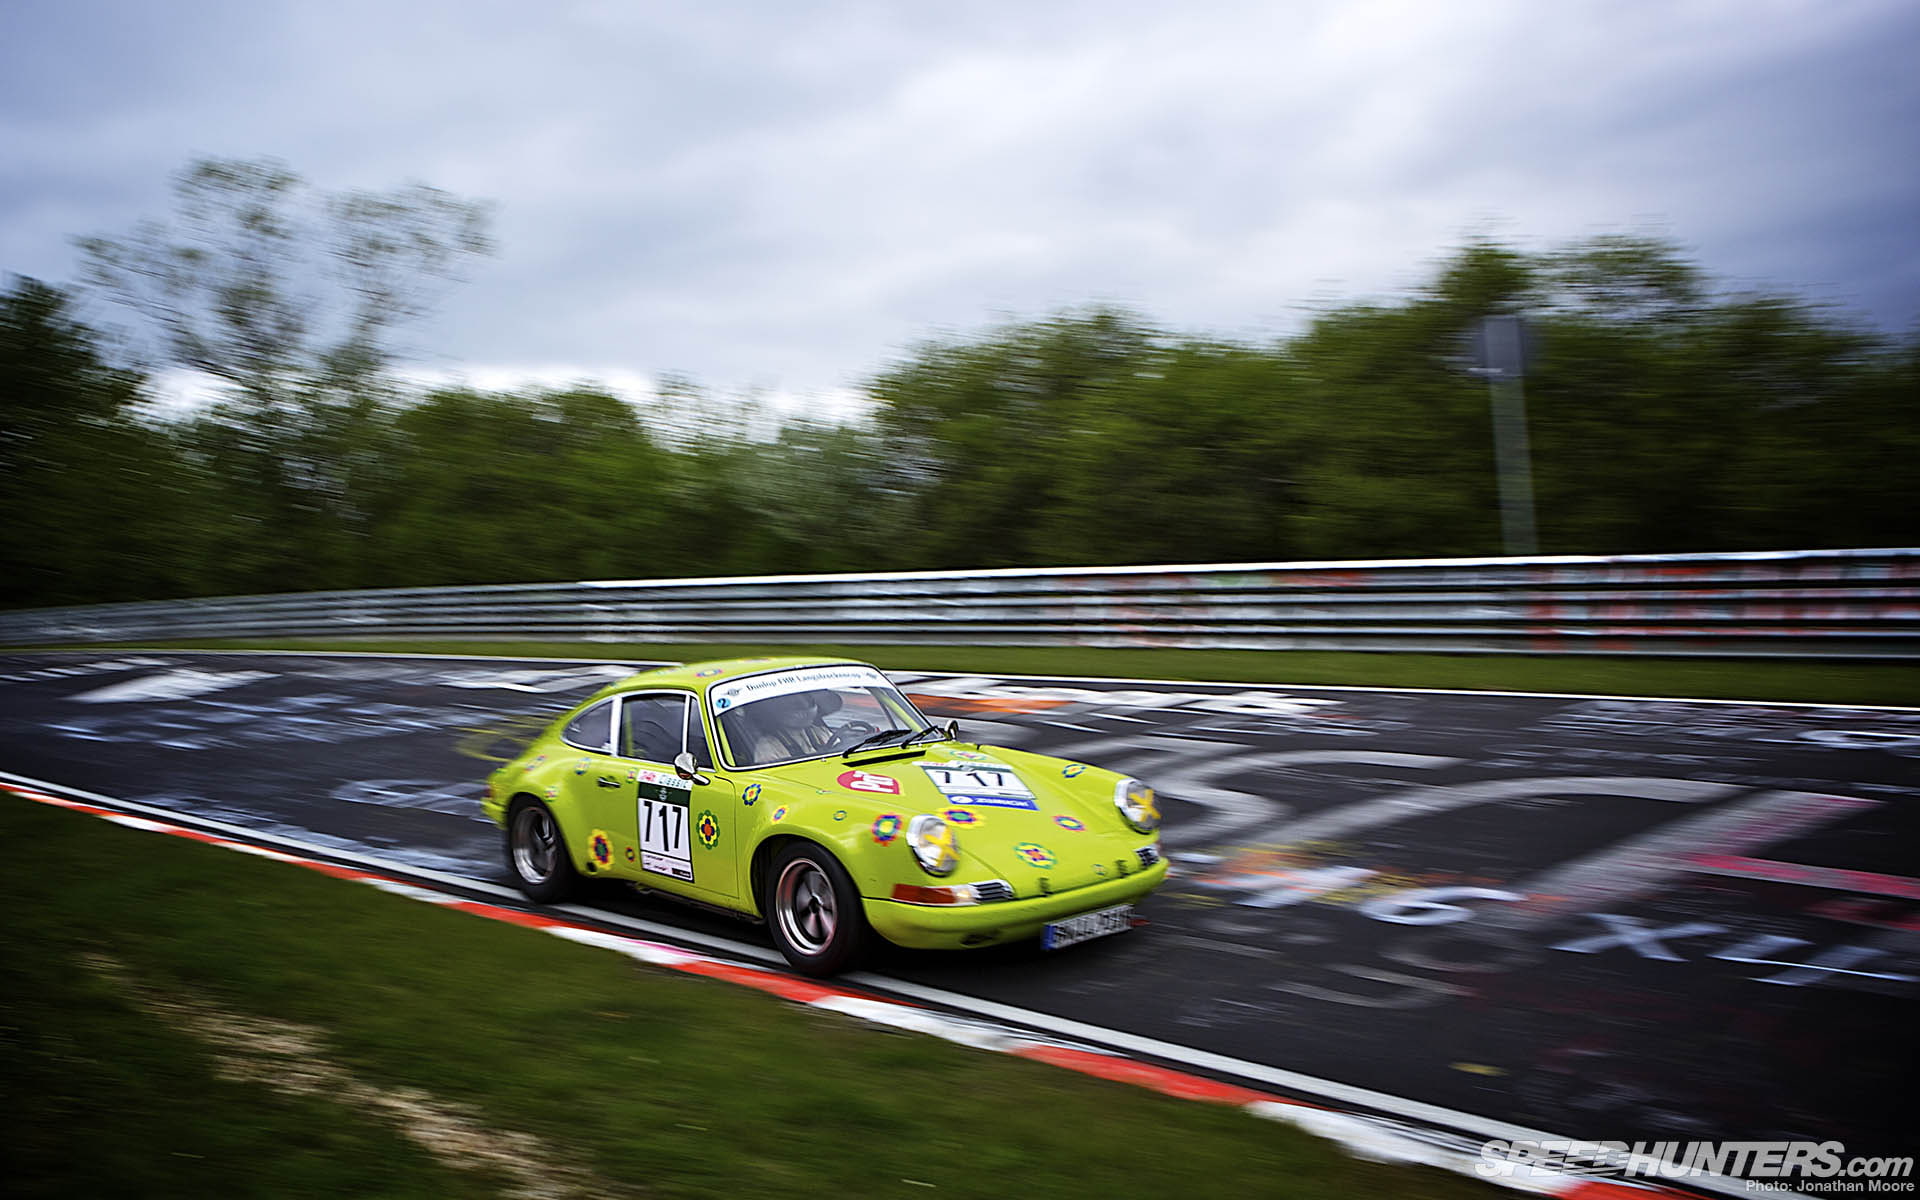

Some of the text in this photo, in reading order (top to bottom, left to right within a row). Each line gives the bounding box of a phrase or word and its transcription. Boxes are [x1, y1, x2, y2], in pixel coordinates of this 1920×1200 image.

[746, 680, 777, 692] Dunlop
[936, 771, 1004, 787] 717
[643, 800, 682, 852] 717
